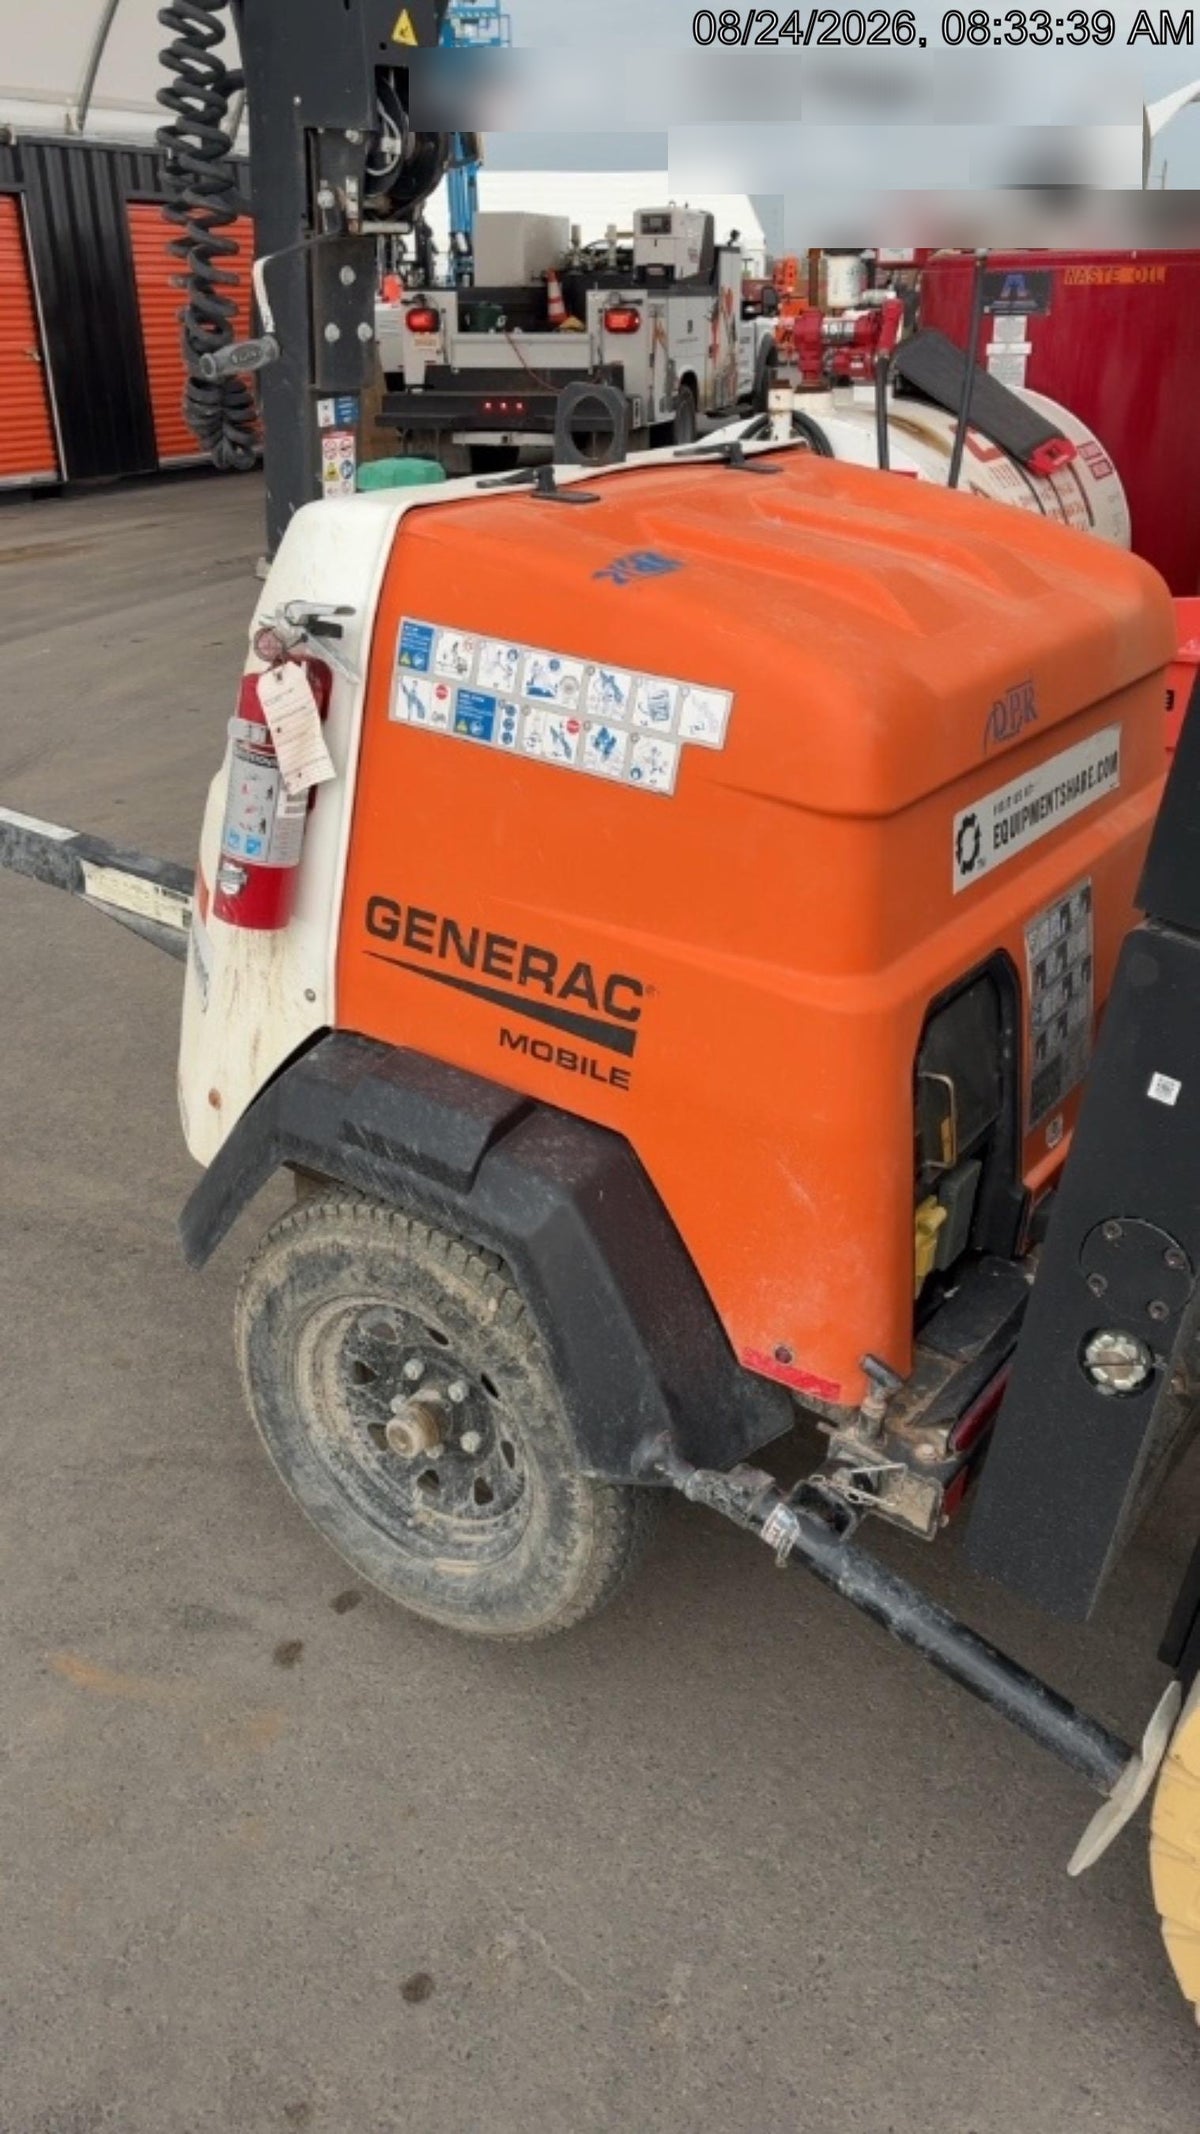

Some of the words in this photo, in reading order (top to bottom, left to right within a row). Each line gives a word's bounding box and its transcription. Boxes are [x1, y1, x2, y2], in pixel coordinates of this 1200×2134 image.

[1065, 266, 1121, 285] WASTE
[1133, 266, 1164, 284] OIL
[993, 751, 1118, 850] EQUIPMENTSHARE.COM
[365, 895, 644, 1022] GENERAC
[499, 1028, 632, 1091] MOBILE
